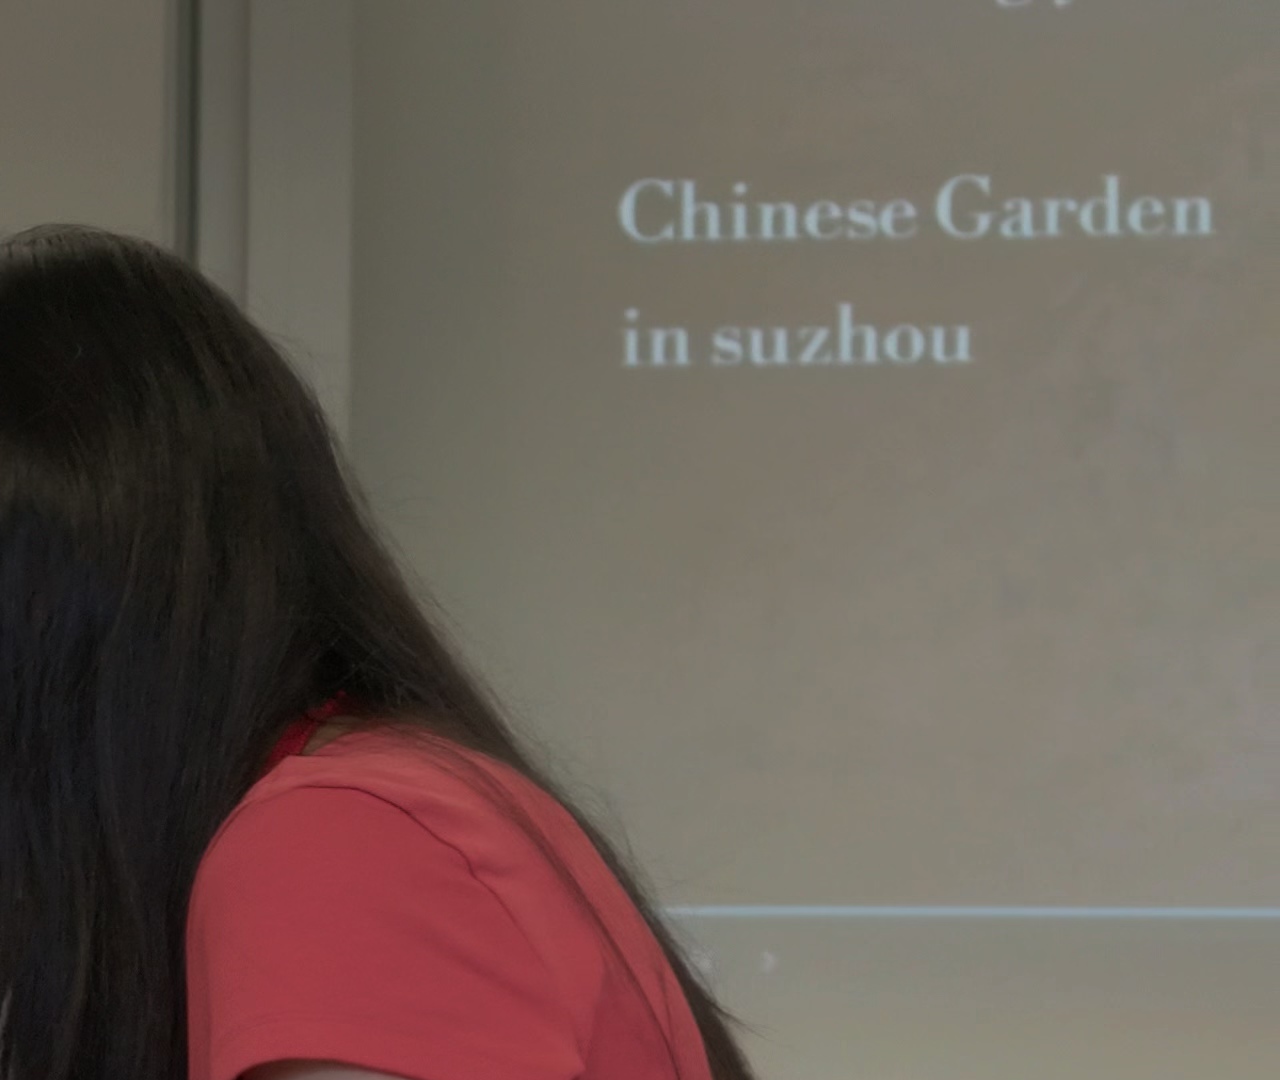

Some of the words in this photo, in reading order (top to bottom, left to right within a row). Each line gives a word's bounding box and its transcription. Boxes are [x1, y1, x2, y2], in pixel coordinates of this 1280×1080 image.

[618, 179, 918, 242] Chinese
[935, 174, 1214, 239] Garden
[622, 307, 691, 367] in
[711, 303, 973, 366] suzhou
